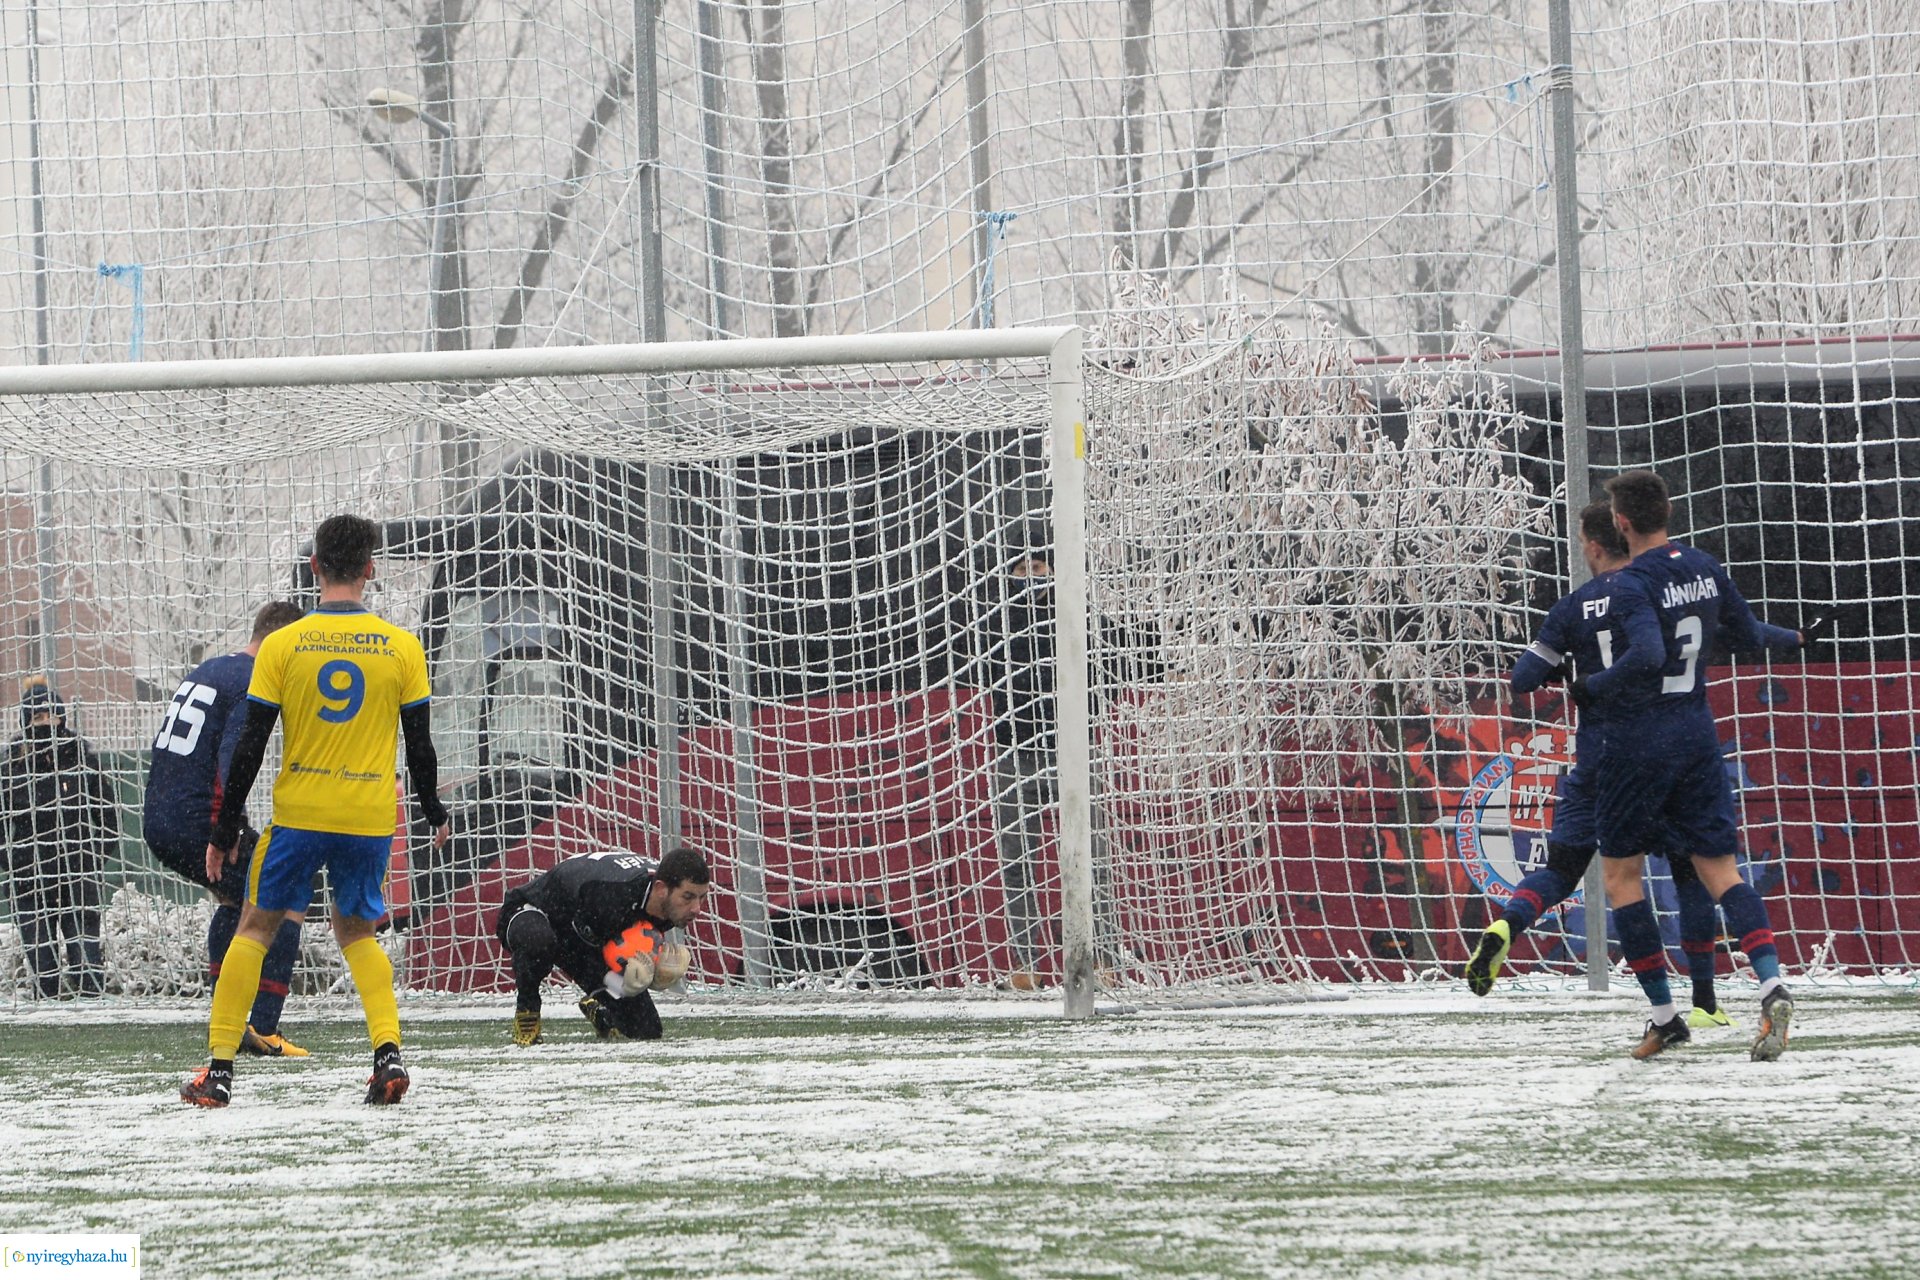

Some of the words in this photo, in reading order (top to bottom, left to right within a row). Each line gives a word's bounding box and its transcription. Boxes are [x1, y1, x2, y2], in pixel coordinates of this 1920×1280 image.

[294, 644, 380, 656] KAZINCBARCIKA
[382, 649, 395, 657] SC
[299, 630, 390, 646] KOLORCITY
[1661, 615, 1703, 694] 3
[155, 681, 218, 757] 55
[317, 659, 365, 724] 9
